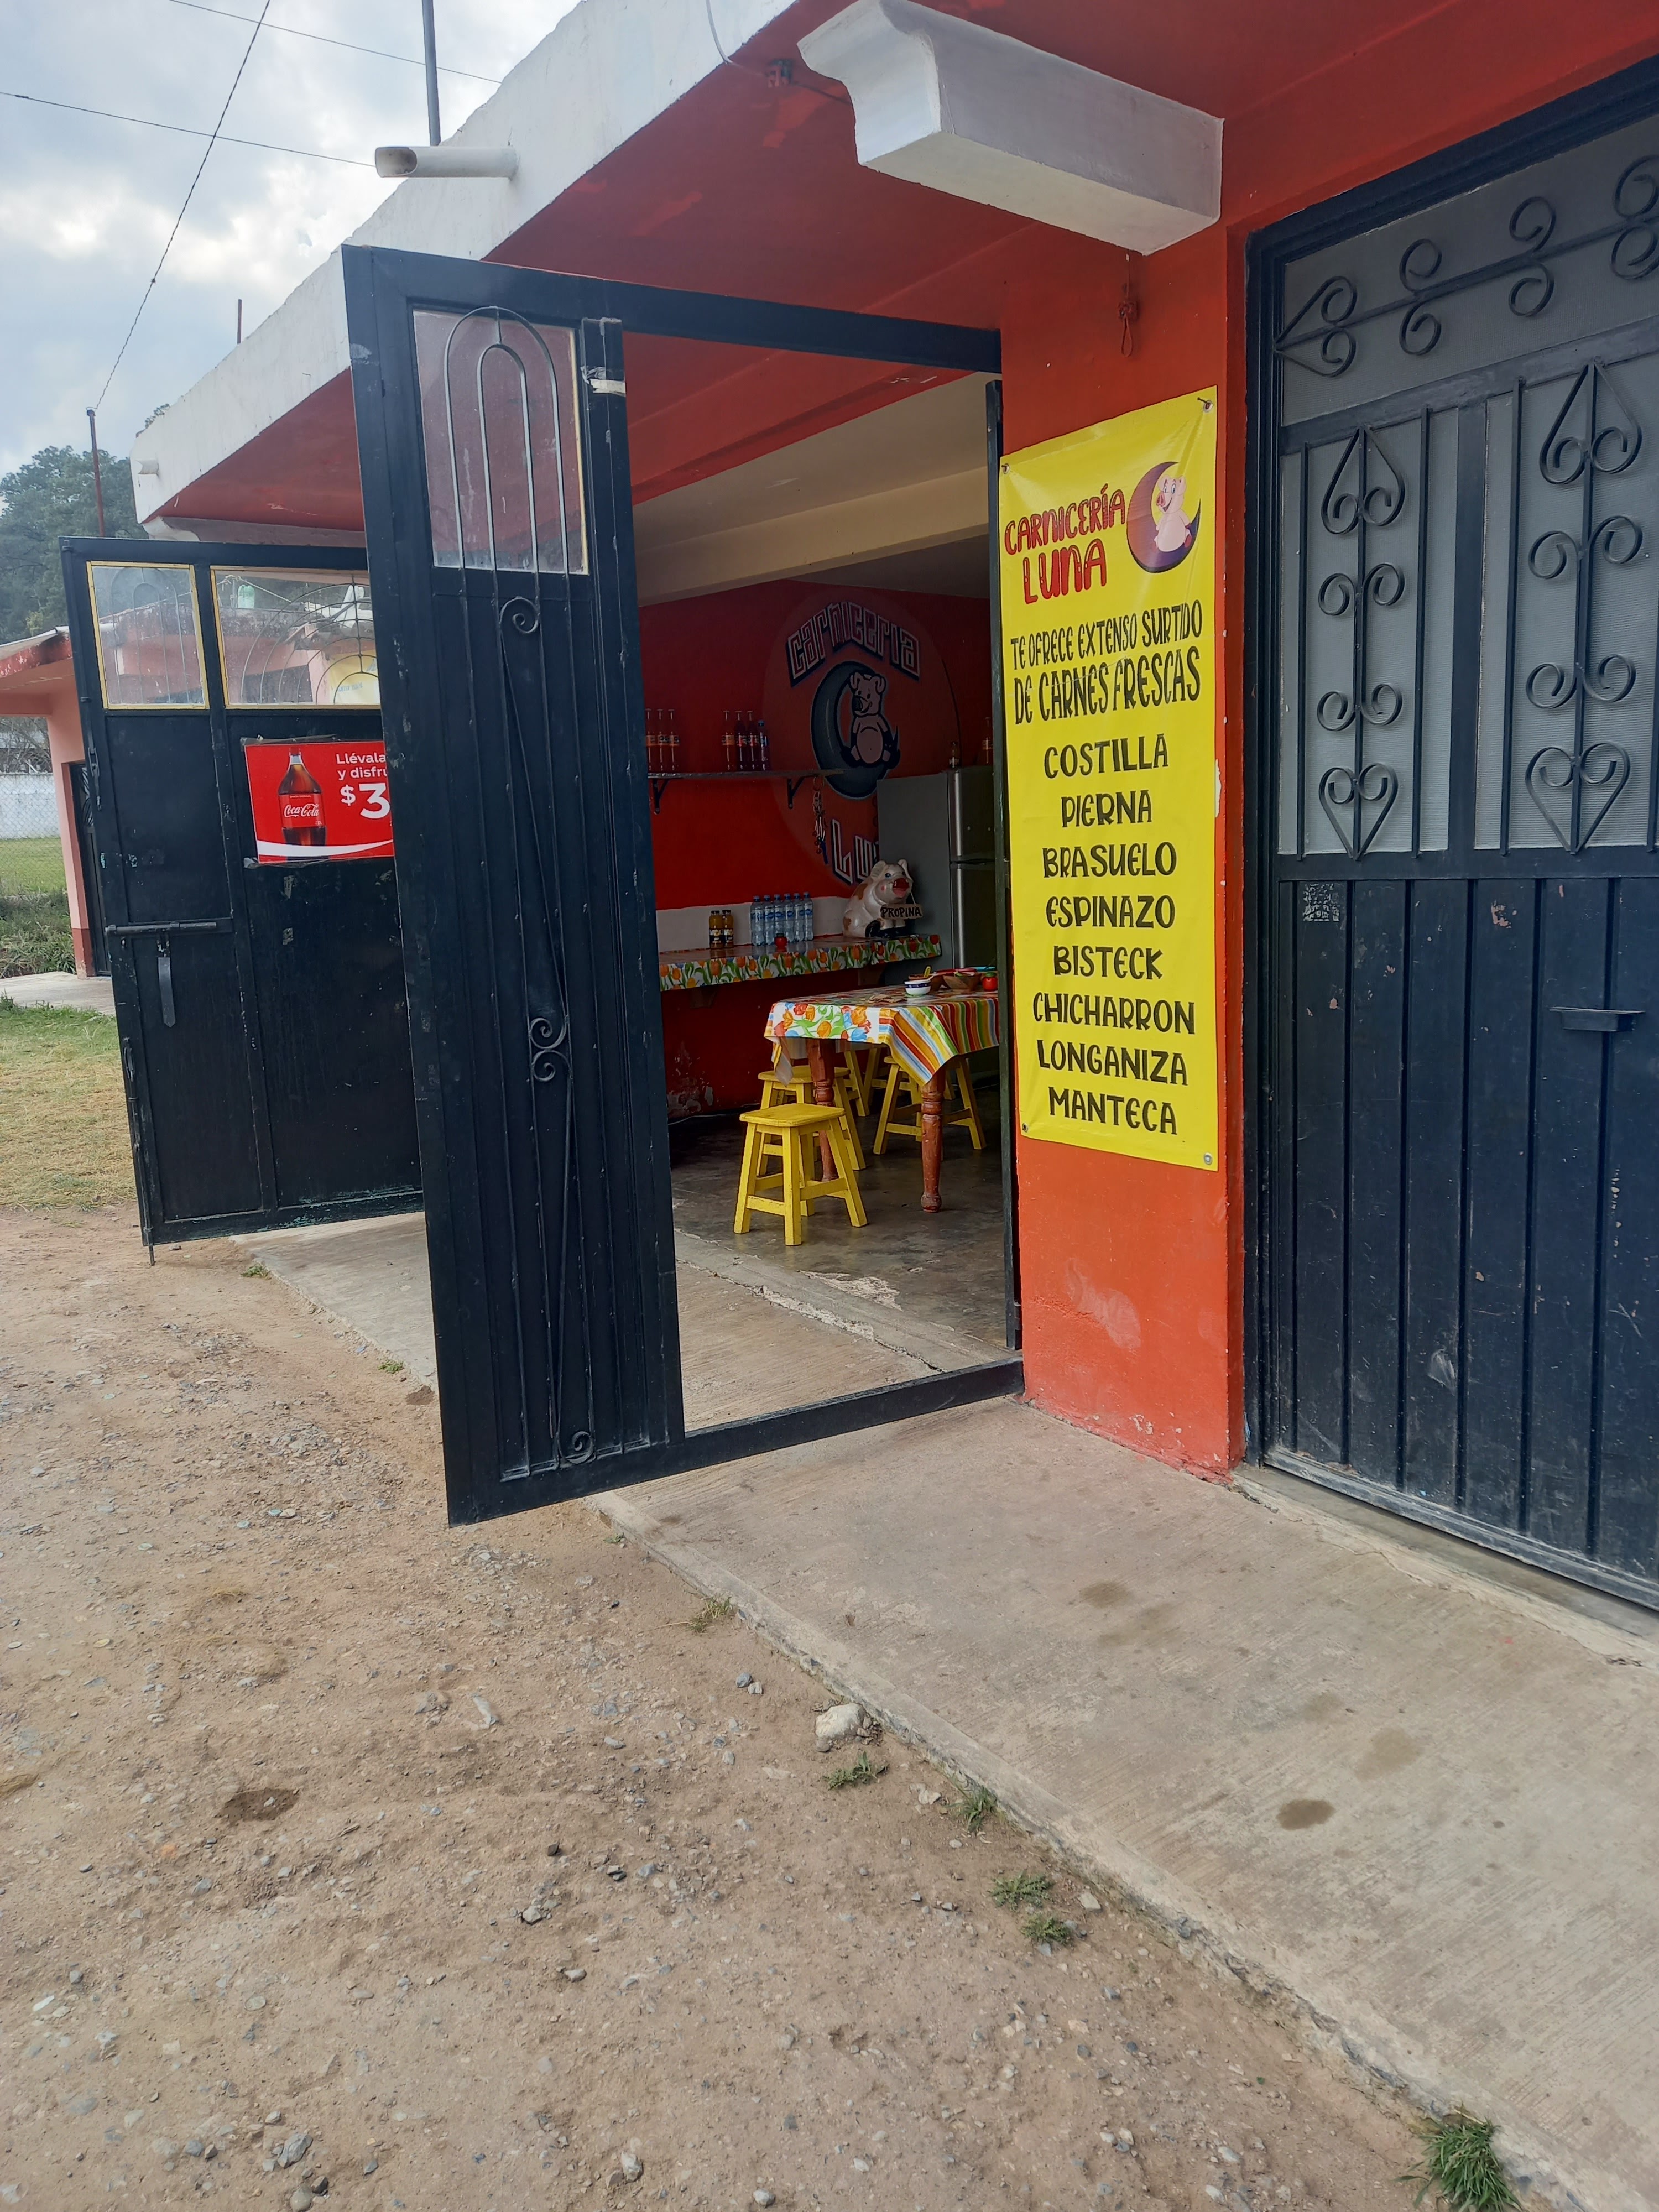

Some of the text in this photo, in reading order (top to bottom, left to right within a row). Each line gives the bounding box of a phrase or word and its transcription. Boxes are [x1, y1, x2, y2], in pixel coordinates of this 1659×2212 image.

[1005, 483, 1126, 555] CARNICERÍA
[1023, 539, 1107, 604] LUNA
[1010, 599, 1203, 670] TE OFRECE EXTENSO SURTIDO
[1014, 646, 1201, 724] DE CARNES FRESCAS
[336, 752, 386, 764] Llévala
[337, 770, 346, 780] y
[1044, 733, 1168, 779] COSTILLA
[1061, 790, 1152, 827] PIERNA
[1042, 841, 1177, 879] BRASUELO
[881, 906, 922, 918] PROPINA
[1046, 895, 1175, 928] ESPINAZO
[1054, 946, 1163, 980] BISTECK
[1033, 992, 1196, 1035] CHICHARRON
[1037, 1039, 1188, 1086] LONGANIZA
[1049, 1086, 1178, 1135] MANTECA
